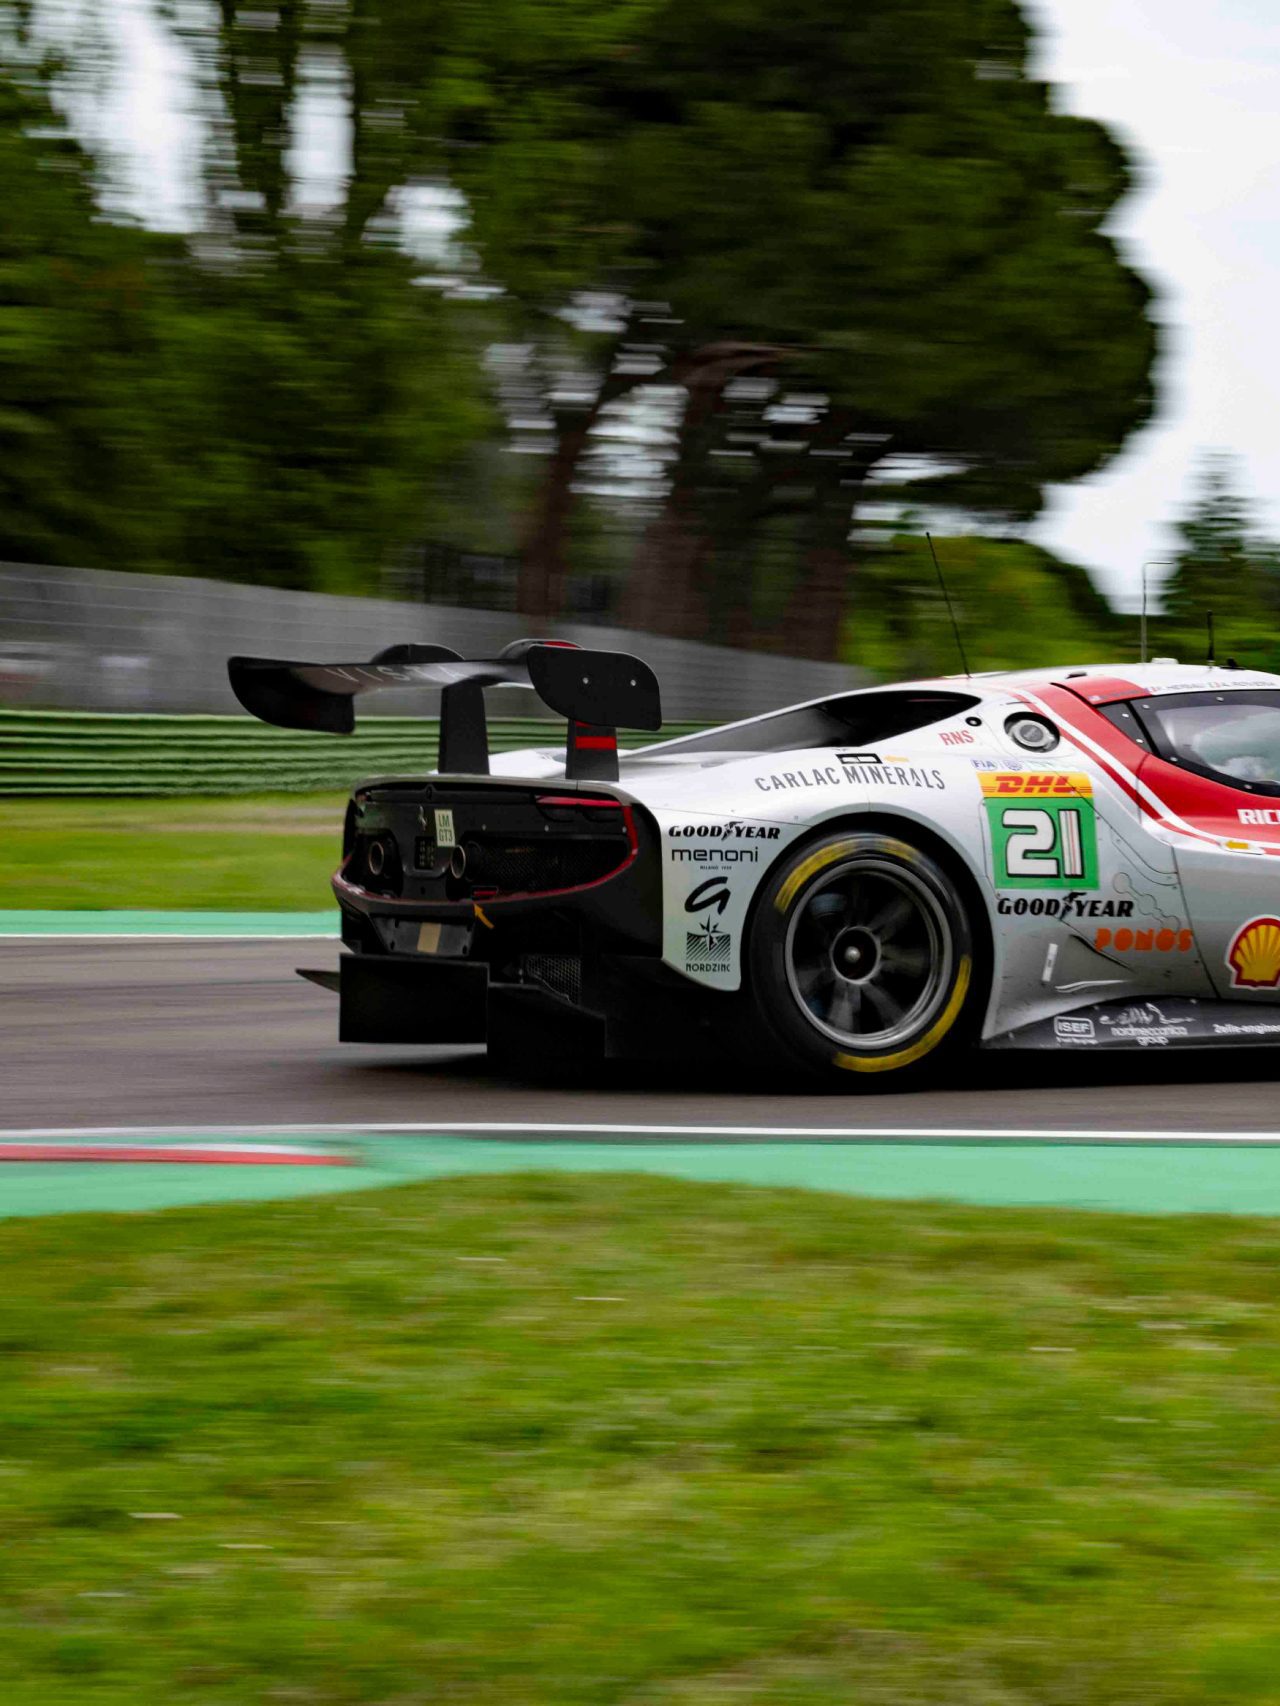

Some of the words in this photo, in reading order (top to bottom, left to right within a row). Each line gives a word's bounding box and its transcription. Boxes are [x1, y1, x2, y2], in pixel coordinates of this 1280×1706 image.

[938, 730, 974, 746] RNS
[754, 767, 840, 791] CARLAC
[842, 765, 945, 790] MINERALS
[995, 776, 1077, 793] DHL
[438, 814, 450, 828] LM
[440, 829, 453, 842] GT3
[1002, 808, 1085, 878] 21
[671, 846, 758, 862] menoni
[1095, 928, 1193, 951] PONOS
[686, 963, 730, 972] NORDZINC
[1059, 1022, 1090, 1033] ISEF
[1136, 1036, 1169, 1046] group
